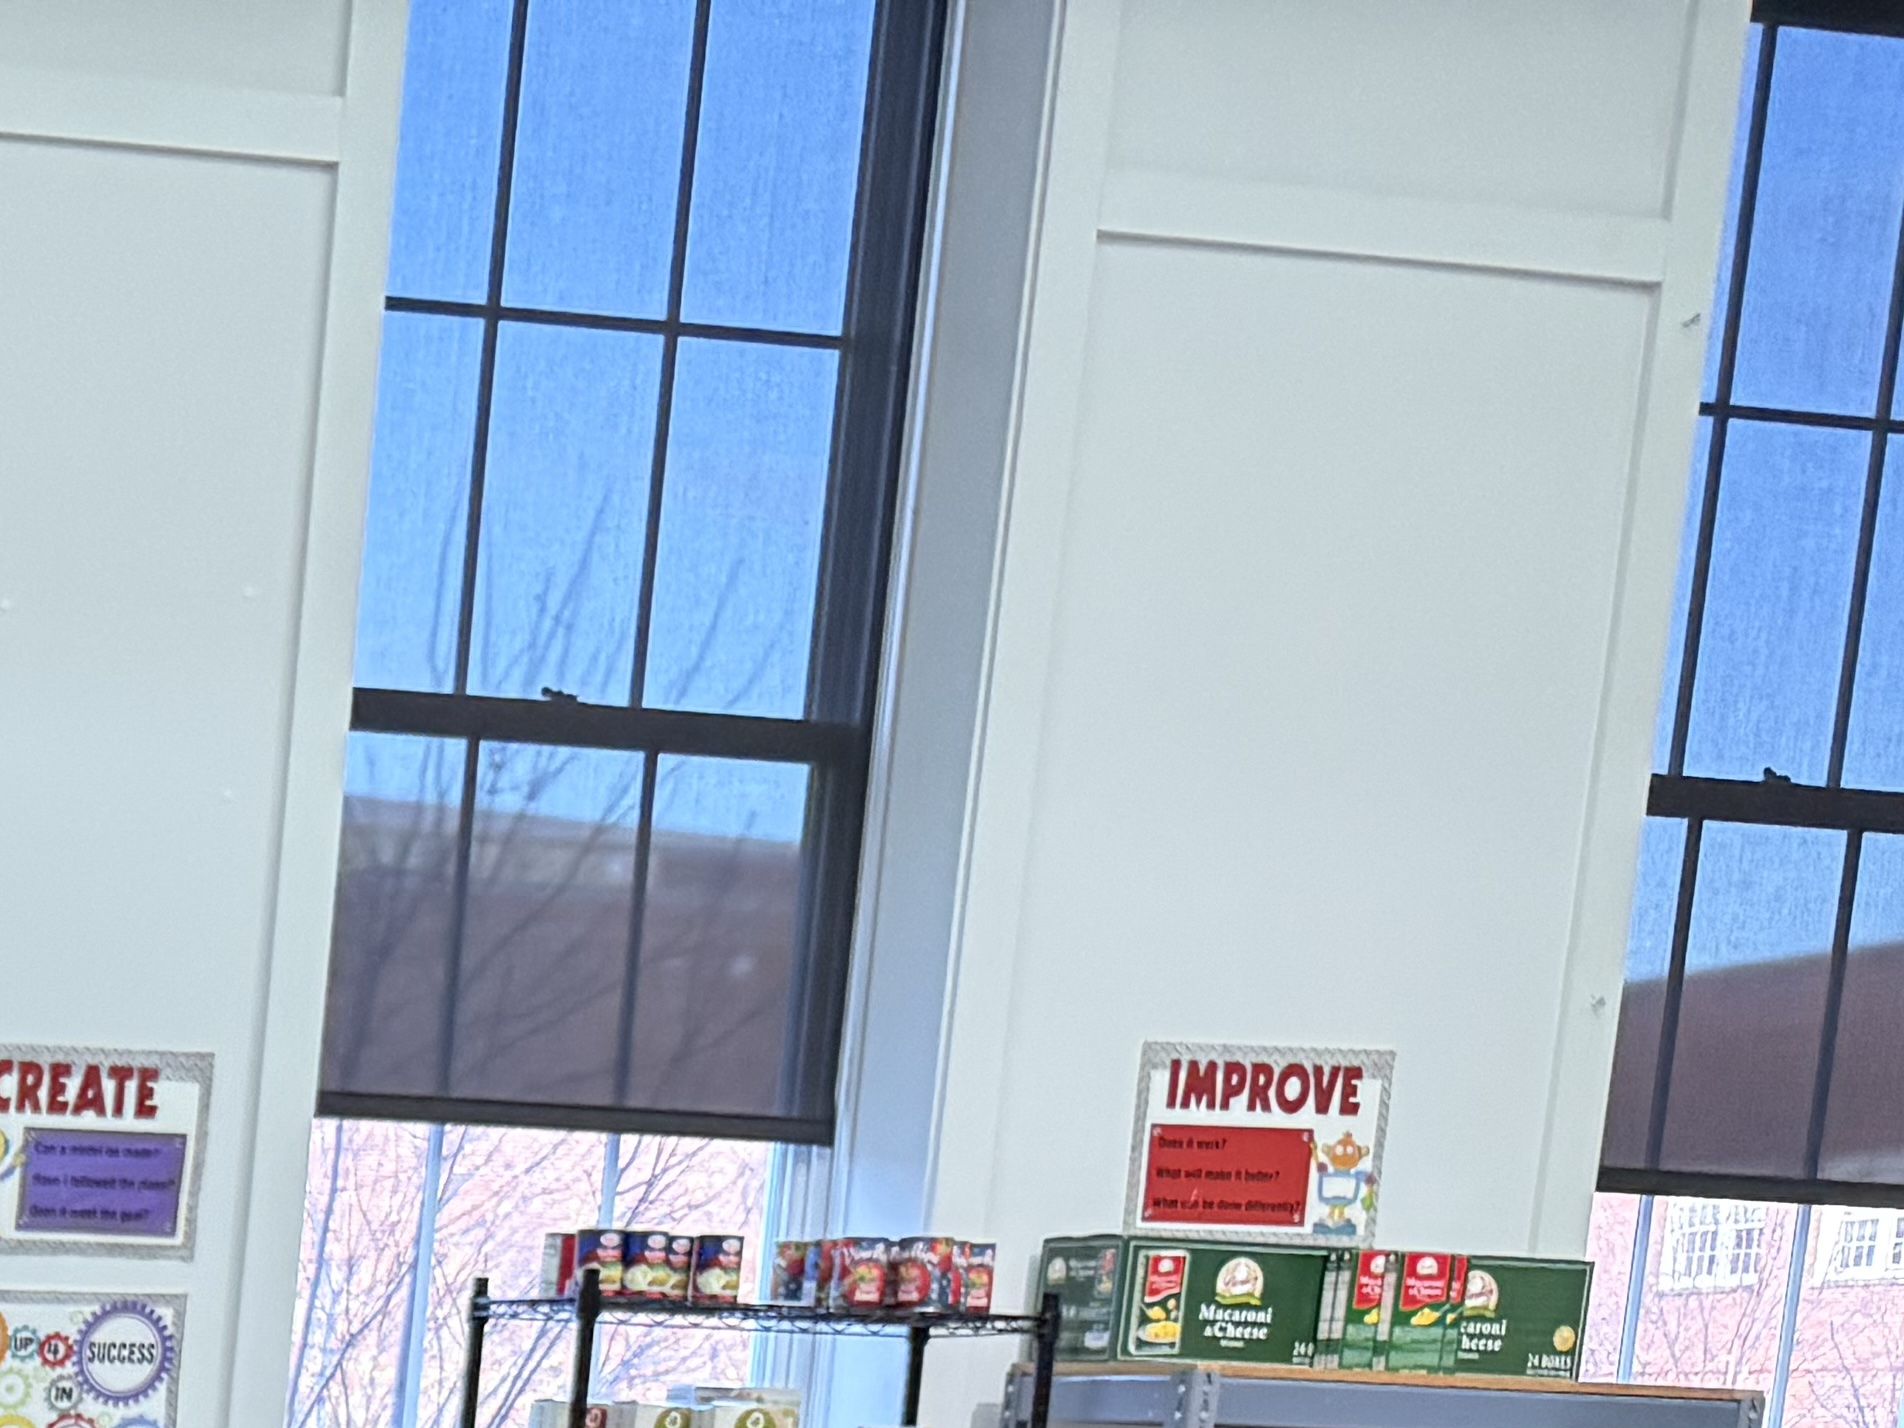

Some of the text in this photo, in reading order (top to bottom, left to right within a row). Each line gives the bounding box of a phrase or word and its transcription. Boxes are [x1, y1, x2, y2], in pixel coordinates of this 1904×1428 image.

[1166, 1059, 1363, 1116] IMPROVE
[1198, 1303, 1273, 1325] Macaroni
[1213, 1321, 1268, 1340] Cheese
[1460, 1319, 1507, 1337] caroni
[14, 1337, 34, 1352] UP
[47, 1342, 60, 1359] 4
[1461, 1335, 1502, 1351] heese
[87, 1341, 156, 1364] SUCCESS
[55, 1386, 73, 1402] IN
